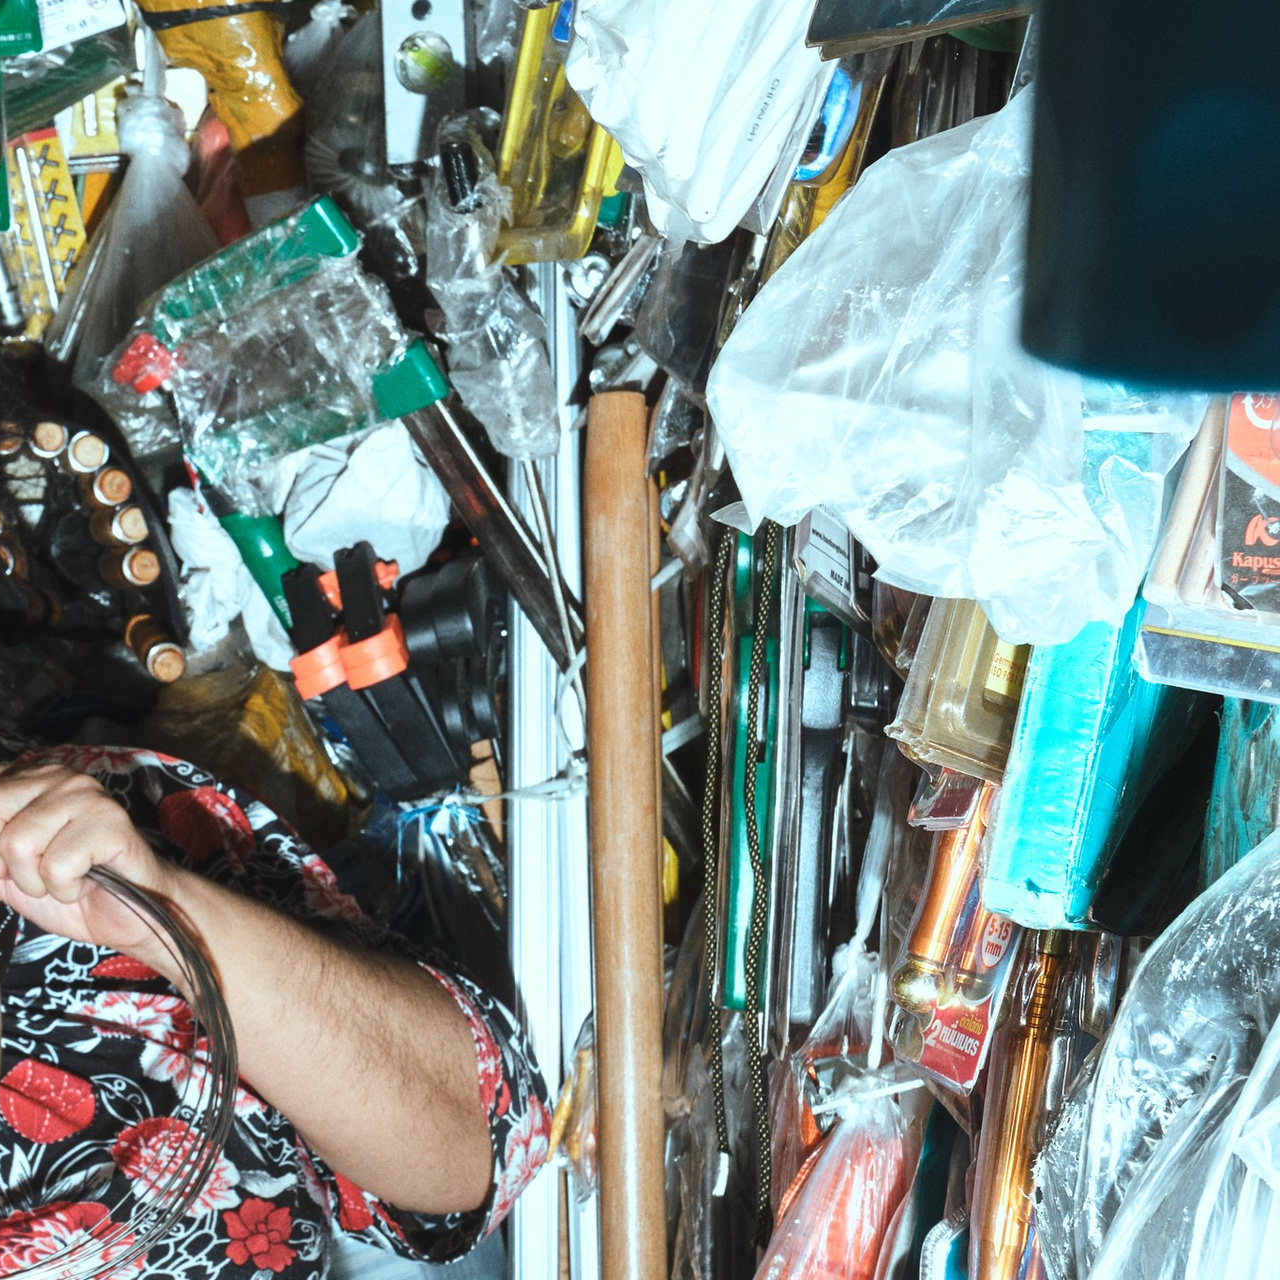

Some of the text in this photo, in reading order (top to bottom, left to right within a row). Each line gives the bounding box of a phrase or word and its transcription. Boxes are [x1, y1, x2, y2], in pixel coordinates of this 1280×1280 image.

[1233, 552, 1280, 571] Kapus
[830, 570, 844, 587] MADE
[988, 923, 1011, 941] 5-15
[985, 942, 1003, 958] mm
[925, 1019, 941, 1045] 2
